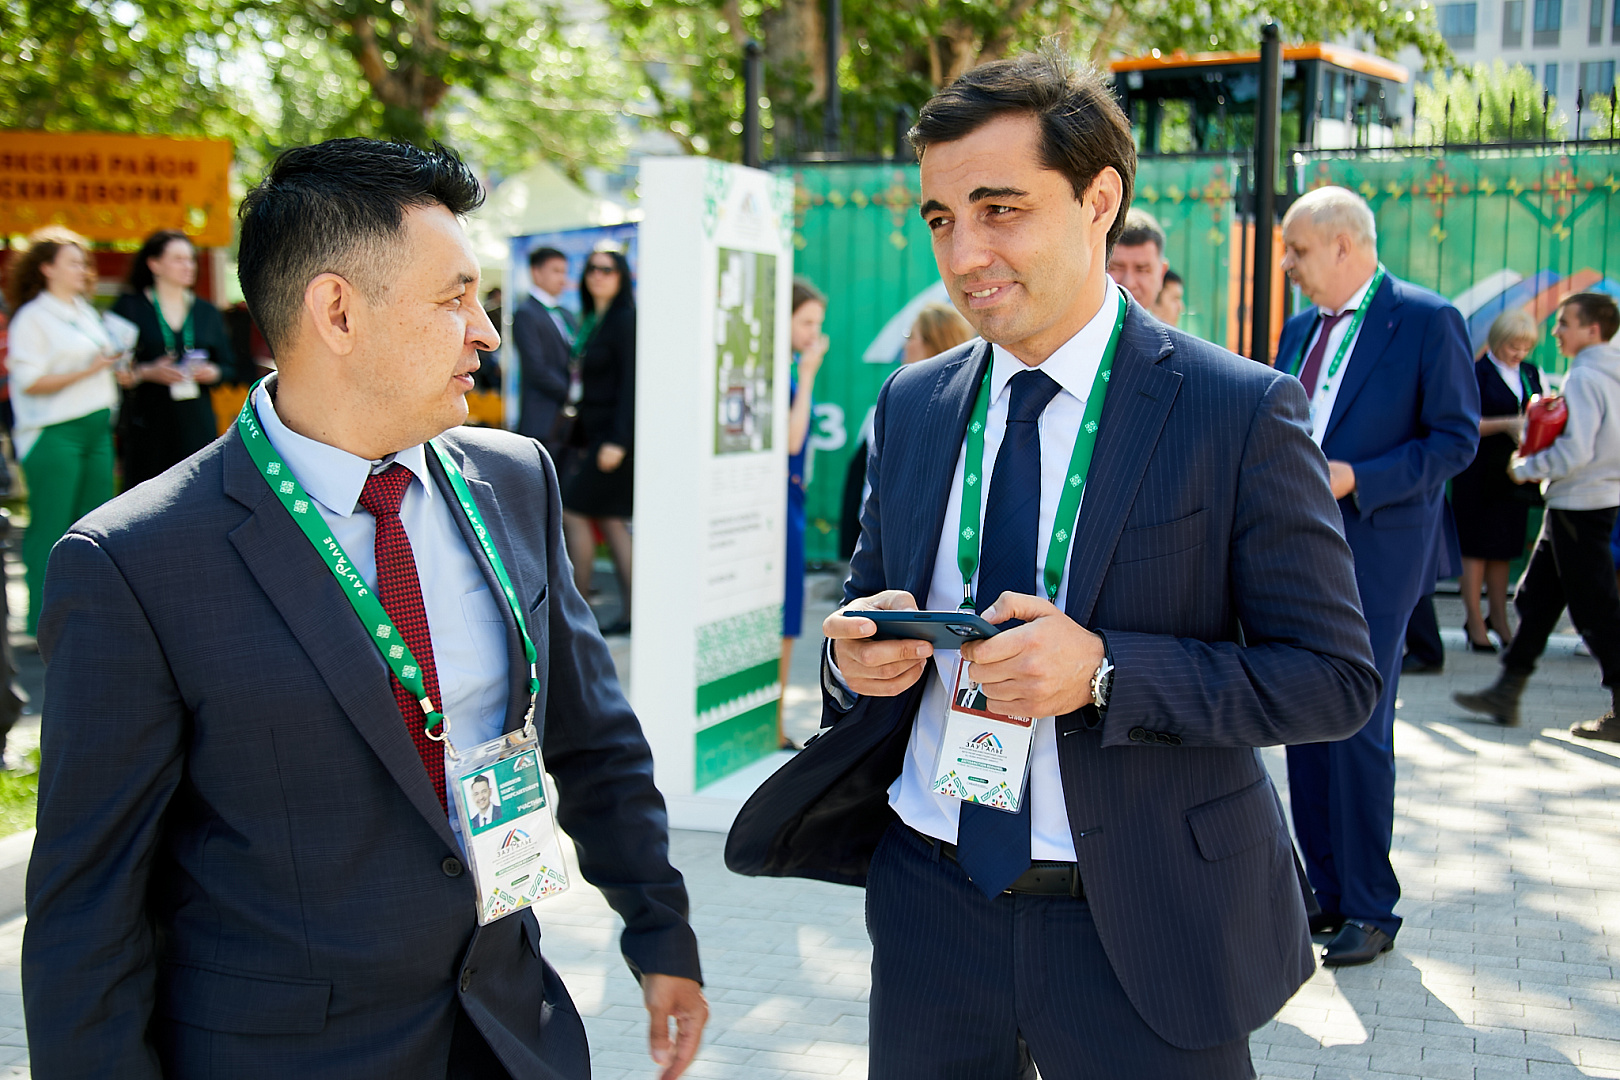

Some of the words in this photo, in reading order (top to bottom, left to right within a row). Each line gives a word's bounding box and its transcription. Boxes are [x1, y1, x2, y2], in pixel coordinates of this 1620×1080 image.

[107, 152, 199, 178] РАЙОН
[75, 183, 181, 204] ДВОРИК
[462, 501, 496, 559] ЗАУРАЛЬЕ
[323, 536, 368, 597] ЗАУРАЛЬЕ
[965, 741, 1003, 755] ЗАУРАЛЬЕ
[497, 837, 532, 858] ЗАУРАЛЬЕ
